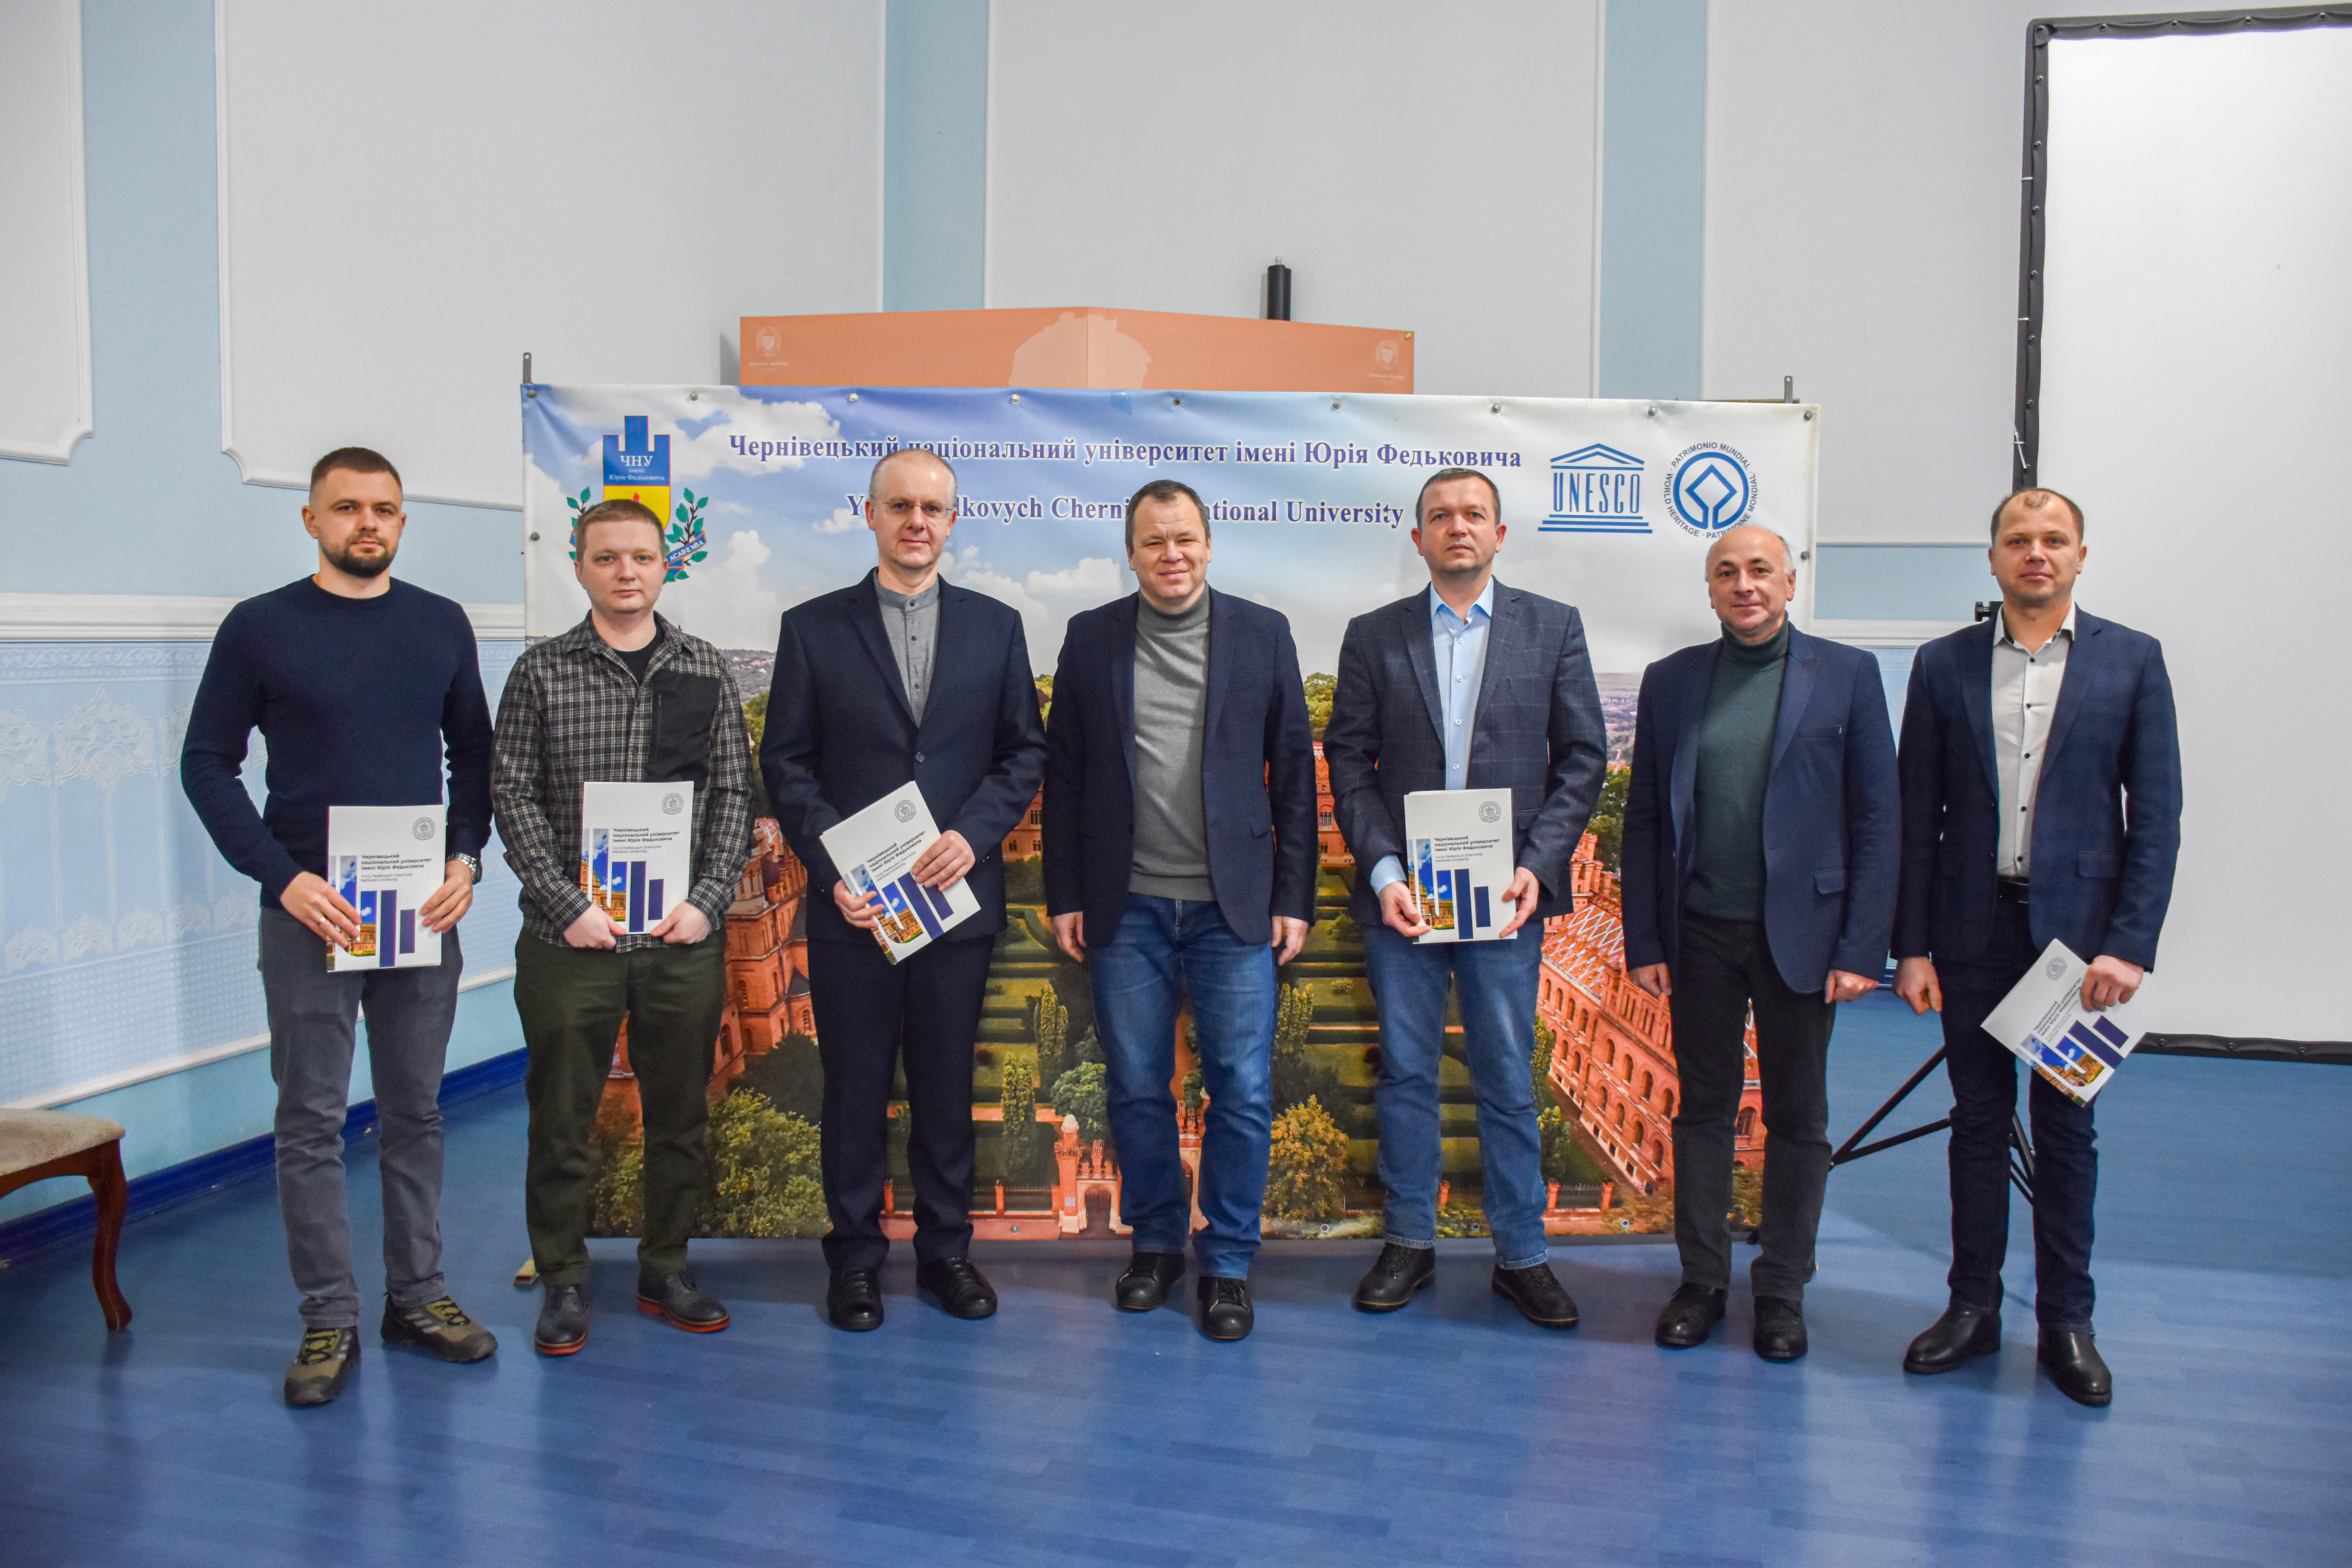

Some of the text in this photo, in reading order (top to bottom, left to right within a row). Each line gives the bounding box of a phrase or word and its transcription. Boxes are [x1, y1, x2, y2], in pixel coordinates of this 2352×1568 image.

[620, 455, 653, 466] ЧНУ
[729, 435, 899, 462] Чернівецький
[1084, 439, 1228, 466] університет
[1236, 441, 1295, 462] імені
[1303, 442, 1368, 469] Юрія
[1377, 444, 1521, 468] Федьковича
[1671, 442, 1750, 470] PATRIMONIO MUNDIAL
[1553, 472, 1640, 514] UNESCO
[1664, 473, 1700, 537] WORLD HERITAGE
[1747, 473, 1758, 512] MONDIAL
[1286, 501, 1404, 528] University
[669, 540, 704, 561] ACADEMIA
[866, 842, 897, 863] Чернівецький
[869, 831, 926, 868] національний університет
[871, 839, 922, 872] імені Юрія Федьковича
